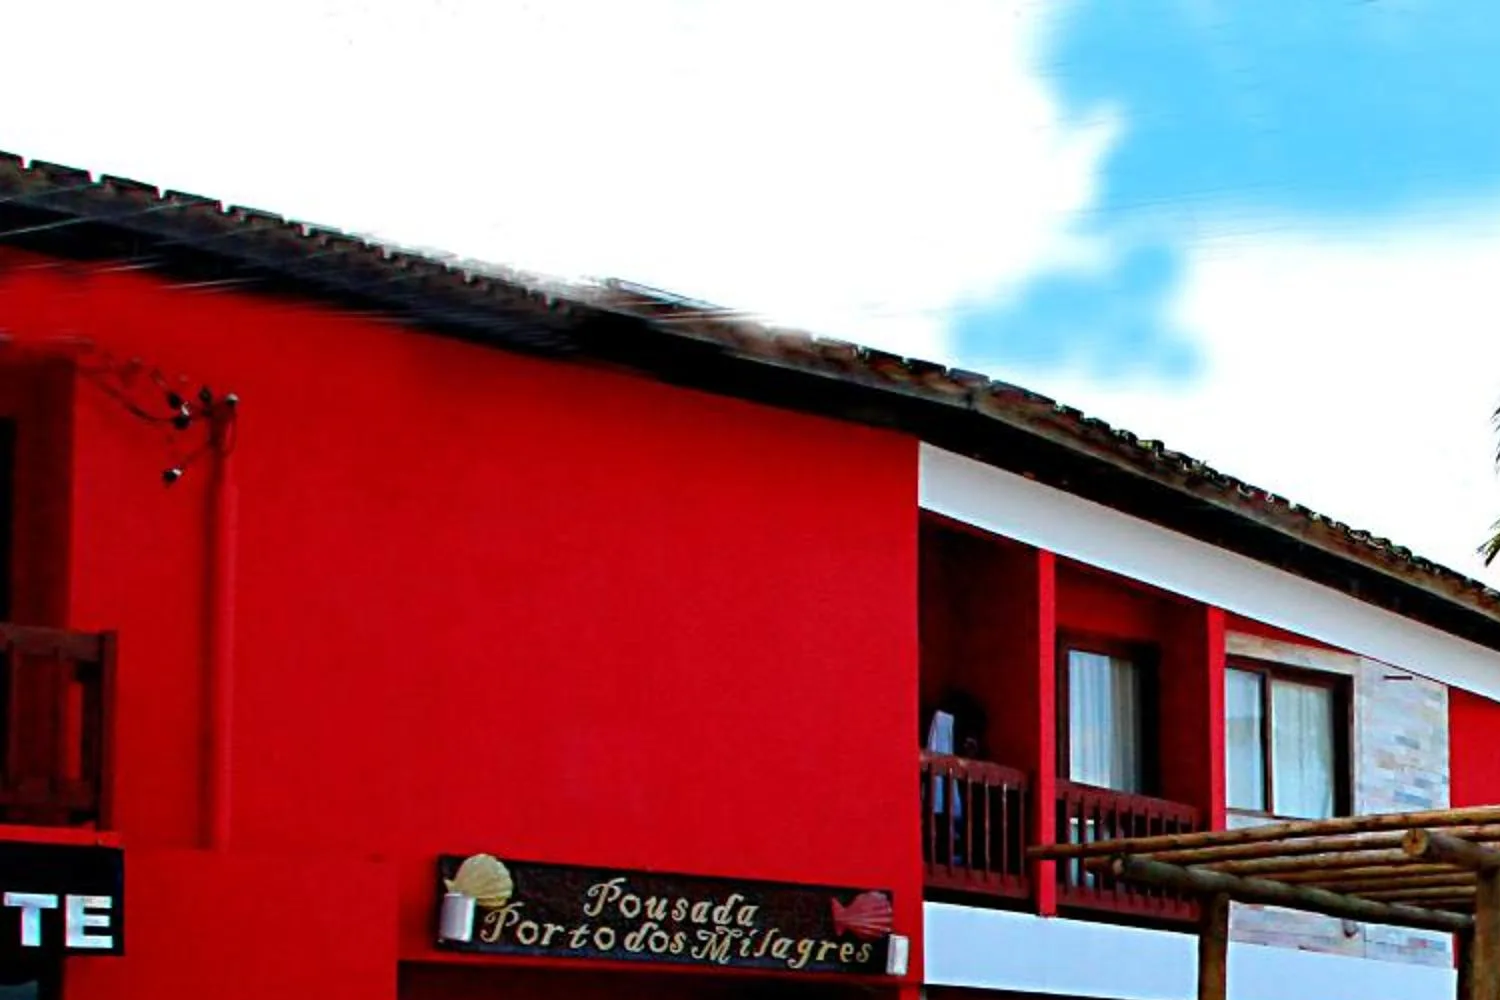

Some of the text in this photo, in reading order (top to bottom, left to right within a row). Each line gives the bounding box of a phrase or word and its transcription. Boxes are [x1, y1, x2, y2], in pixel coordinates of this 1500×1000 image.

[4, 891, 113, 948] TE
[583, 877, 760, 927] Pousada
[480, 901, 873, 969] Porto dos Milagres
